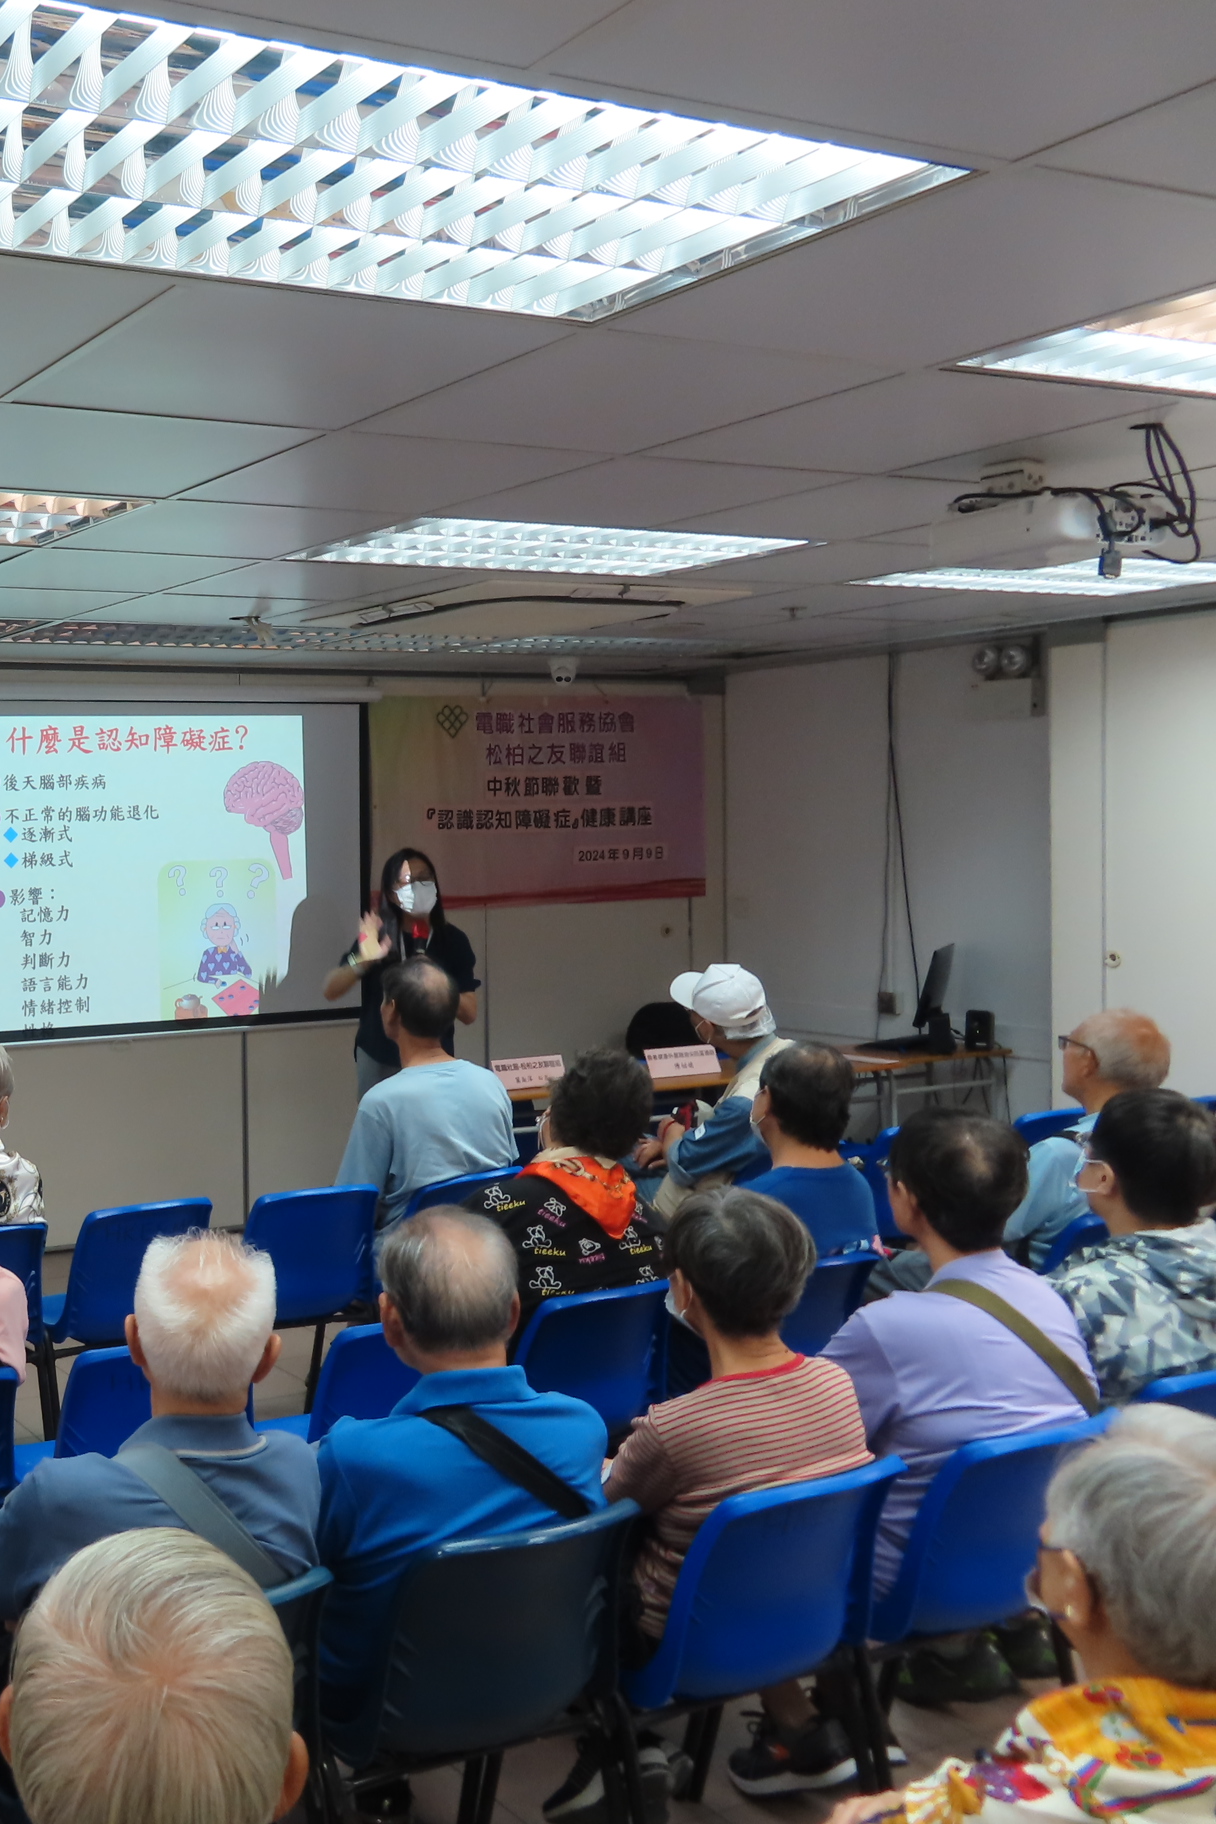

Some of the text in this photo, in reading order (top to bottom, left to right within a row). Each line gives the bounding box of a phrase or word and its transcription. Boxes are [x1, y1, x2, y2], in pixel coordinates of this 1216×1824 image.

[475, 711, 634, 734] 電職社會服務協會
[5, 724, 249, 755] 什麼是認知障礙症?
[486, 742, 627, 766] 松柏之友聯誼組
[2, 773, 107, 792] 後天腦部疾病
[487, 775, 602, 798] 中秋節聯歡暨
[4, 804, 160, 825] 不正常的腦功能退化
[21, 824, 73, 843] 逐漸式
[21, 850, 74, 869] 梯級式
[20, 905, 70, 923] 記憶力
[20, 929, 53, 947] 智力
[21, 951, 70, 970] 判斷力
[21, 973, 89, 992] 語言能力
[21, 996, 90, 1018] 情緒控制
